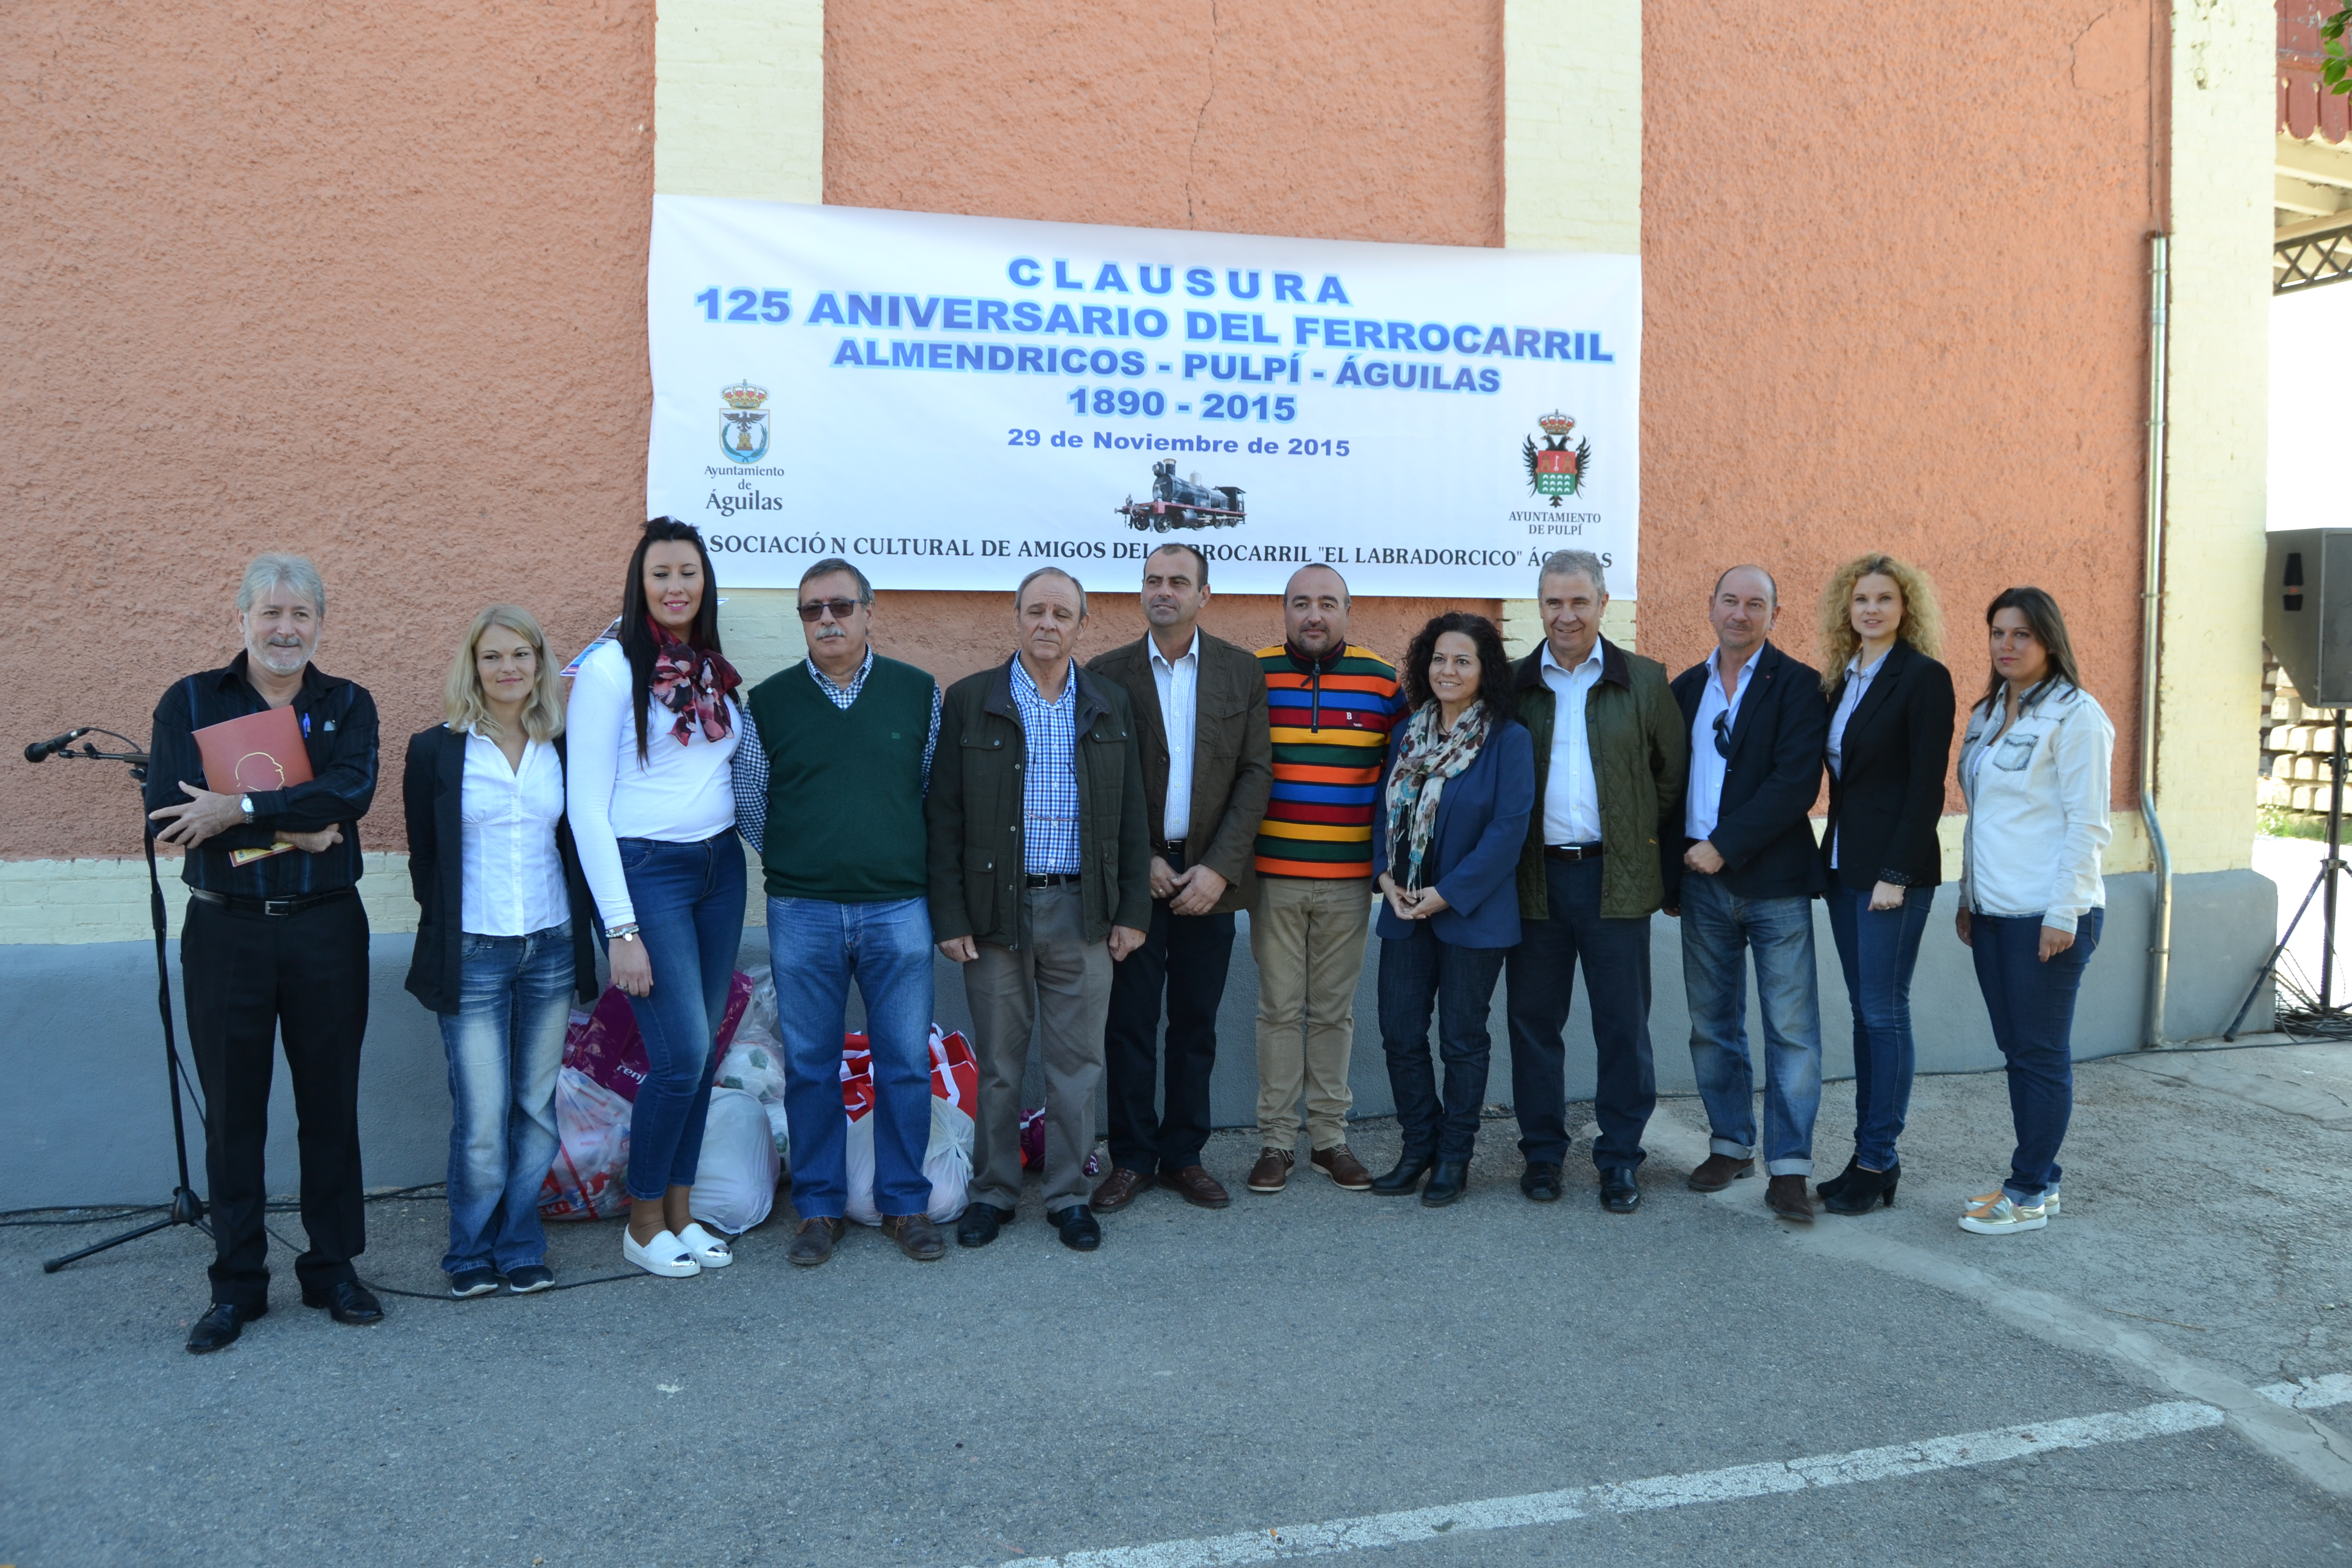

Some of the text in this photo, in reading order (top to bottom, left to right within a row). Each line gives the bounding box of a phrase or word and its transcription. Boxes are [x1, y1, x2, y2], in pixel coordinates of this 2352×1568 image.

[1008, 257, 1351, 305] CLAUSURA
[696, 287, 1614, 362] 125 ANIVERSARIO DEL FERROCARRIL
[833, 339, 1146, 377] ALMENDRICOS
[1184, 352, 1301, 383] PULPÍ
[1335, 355, 1501, 392] ÁGUILAS
[1069, 387, 1165, 417] 1890
[1202, 393, 1296, 422] 2015
[1008, 428, 1350, 457] 29 de Noviembre de 2015
[704, 465, 785, 479] Ayuntamiento
[738, 478, 752, 490] de
[705, 488, 783, 517] Águilas
[1508, 510, 1602, 523] AYUNTAMIENTO
[1529, 523, 1583, 535] DE PULPÍ
[853, 537, 975, 556] CULTURAL
[981, 540, 1011, 557] DE
[1017, 541, 1107, 559] AMIGOS
